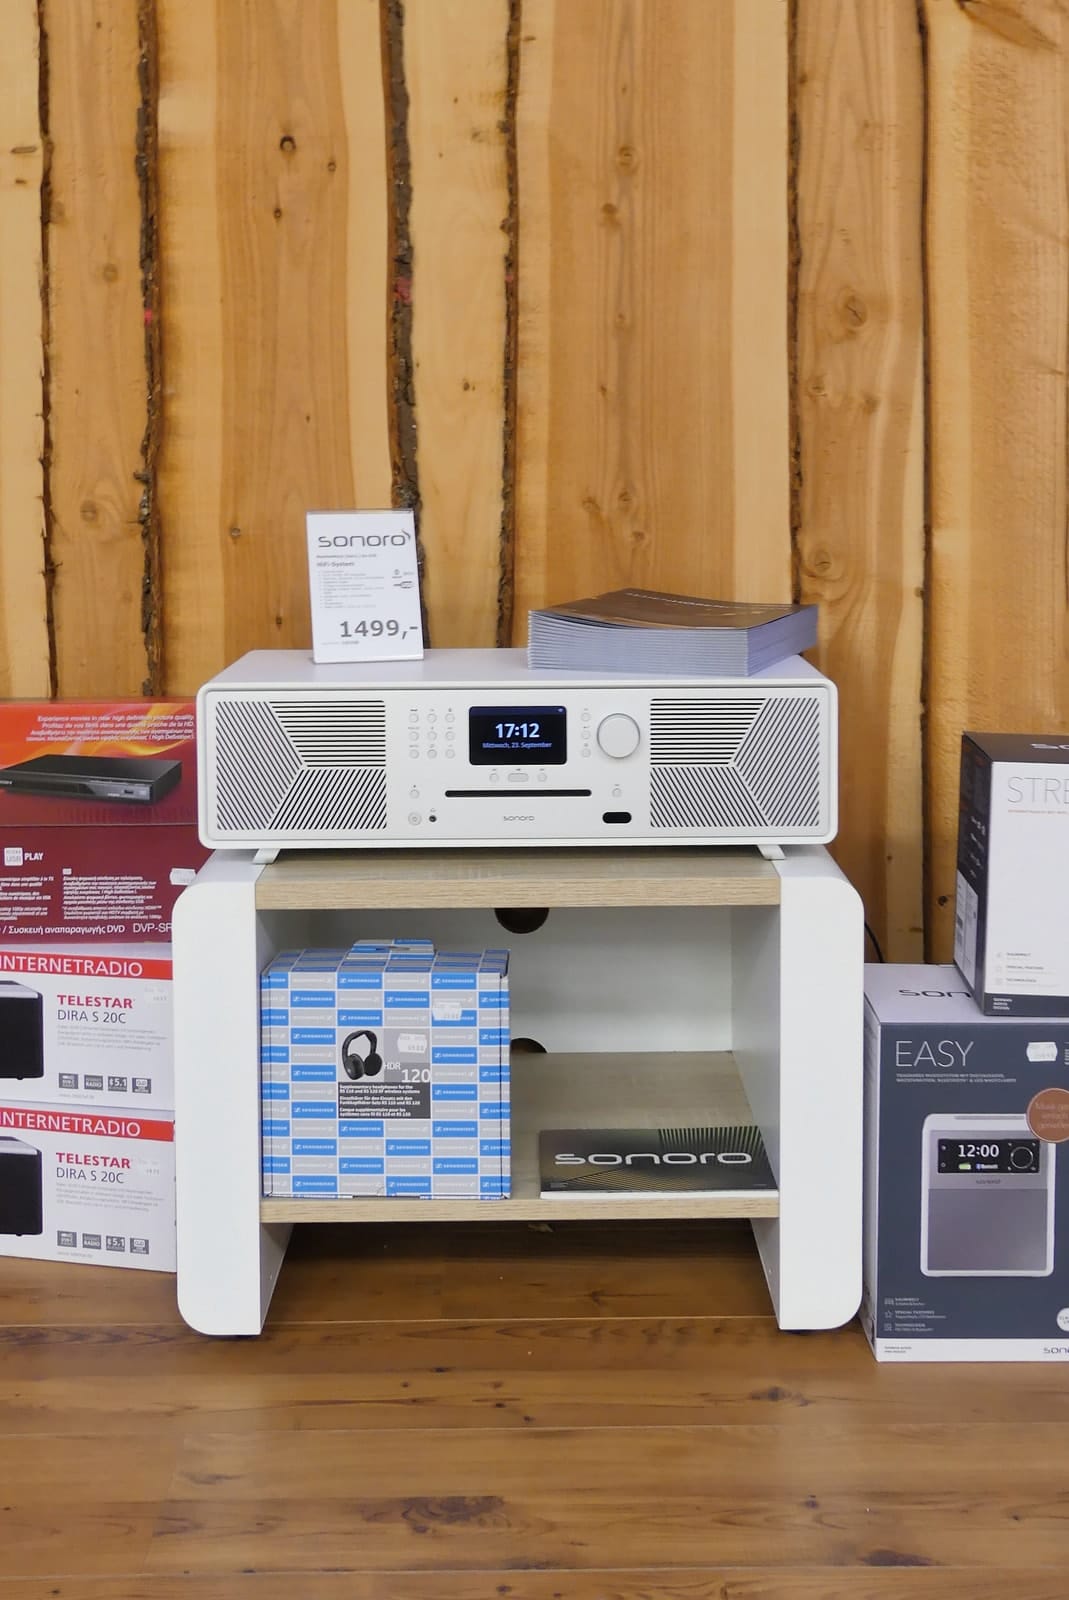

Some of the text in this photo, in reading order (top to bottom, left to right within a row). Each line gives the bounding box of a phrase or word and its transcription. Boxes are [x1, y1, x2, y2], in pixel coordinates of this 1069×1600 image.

[318, 530, 409, 548] sonoro
[340, 619, 418, 640] 1499,-
[495, 723, 540, 738] 17:12
[24, 852, 44, 861] PLAY
[107, 925, 125, 933] DVD
[57, 994, 133, 1009] TELESTAR
[57, 1009, 126, 1024] DIRA S 20C
[895, 1040, 974, 1067] EASY
[401, 1069, 430, 1083] 120
[958, 1144, 999, 1157] 12:00
[56, 1152, 131, 1169] TELESTAR
[554, 1152, 753, 1165] sonoro
[56, 1167, 124, 1184] DIRA S 20C
